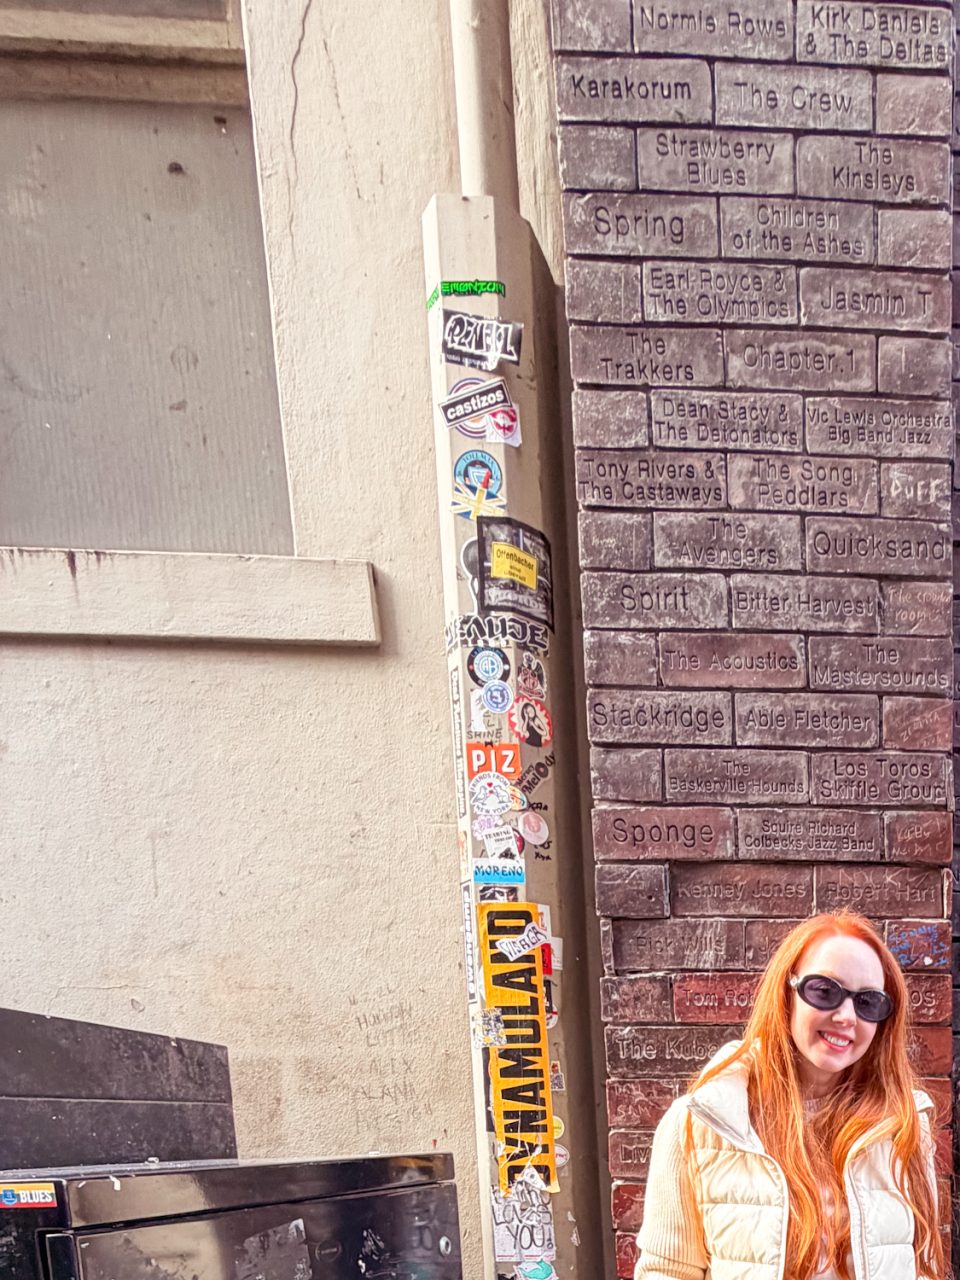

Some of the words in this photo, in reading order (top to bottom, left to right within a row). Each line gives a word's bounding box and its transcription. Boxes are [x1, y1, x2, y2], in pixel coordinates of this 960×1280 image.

[811, 5, 852, 29] Kirk
[861, 8, 942, 35] Daniels
[804, 34, 817, 55] &
[829, 35, 869, 58] The
[879, 37, 949, 63] Deltas
[570, 74, 693, 100] Karakorum
[734, 82, 778, 110] The
[791, 86, 853, 113] Crew
[655, 132, 776, 164] Strawberry
[854, 141, 894, 165] The
[687, 162, 748, 187] Blues
[832, 166, 916, 193] Kinsleys
[594, 206, 685, 244] Spring
[757, 203, 840, 231] Children
[732, 229, 753, 250] of
[761, 231, 793, 253] the
[803, 234, 866, 256] Ashes
[650, 267, 690, 292] Earl
[700, 269, 764, 297] Royce
[773, 271, 786, 293] &
[649, 292, 687, 315] The
[697, 294, 790, 319] Olympics
[820, 286, 907, 315] Jasmin
[917, 290, 933, 307] T
[625, 332, 667, 356] The
[601, 358, 695, 382] Trakkers
[446, 390, 505, 420] castizos
[663, 399, 709, 420] Dean
[717, 401, 769, 427] Stacy
[777, 402, 789, 422] &
[806, 407, 829, 424] Vic
[834, 408, 876, 425] Lewis
[882, 410, 951, 428] Orchestra
[657, 421, 688, 442] The
[697, 424, 798, 446] Detonators
[828, 425, 850, 443] Big
[858, 427, 893, 443] Band
[900, 428, 932, 445] Jazz
[583, 459, 629, 481] Tony
[638, 460, 695, 480] Rivers
[703, 461, 715, 480] &
[753, 458, 791, 481] The
[801, 461, 853, 487] Song
[579, 481, 613, 500] The
[622, 482, 723, 503] Castaways
[758, 483, 849, 507] Peddlars
[707, 518, 748, 539] The
[678, 542, 778, 566] Avengers
[813, 531, 946, 561] Quicksand
[620, 584, 689, 612] Spirit
[736, 591, 790, 614] Bitter
[798, 593, 874, 617] Harvest
[664, 649, 701, 670] The
[710, 650, 799, 671] Acoustics
[862, 643, 899, 664] The
[813, 665, 950, 688] Mastersounds
[592, 702, 725, 731] Stackridge
[745, 708, 787, 729] Able
[794, 710, 871, 732] Fletcher
[722, 760, 751, 777] The
[833, 759, 868, 778] Los
[875, 758, 932, 778] Toros
[669, 777, 747, 795] Baskerville
[752, 778, 806, 795] Hounds
[820, 780, 880, 801] Skiffle
[612, 818, 715, 848] Sponge
[761, 819, 802, 836] Squire
[808, 820, 857, 836] Richard
[744, 834, 803, 850] Colbecks
[807, 835, 837, 851] Jazz
[842, 837, 875, 852] Band
[474, 864, 524, 877] MORENO
[752, 880, 807, 898] Jones
[616, 1037, 658, 1060] The
[20, 1189, 53, 1204] BLUES
